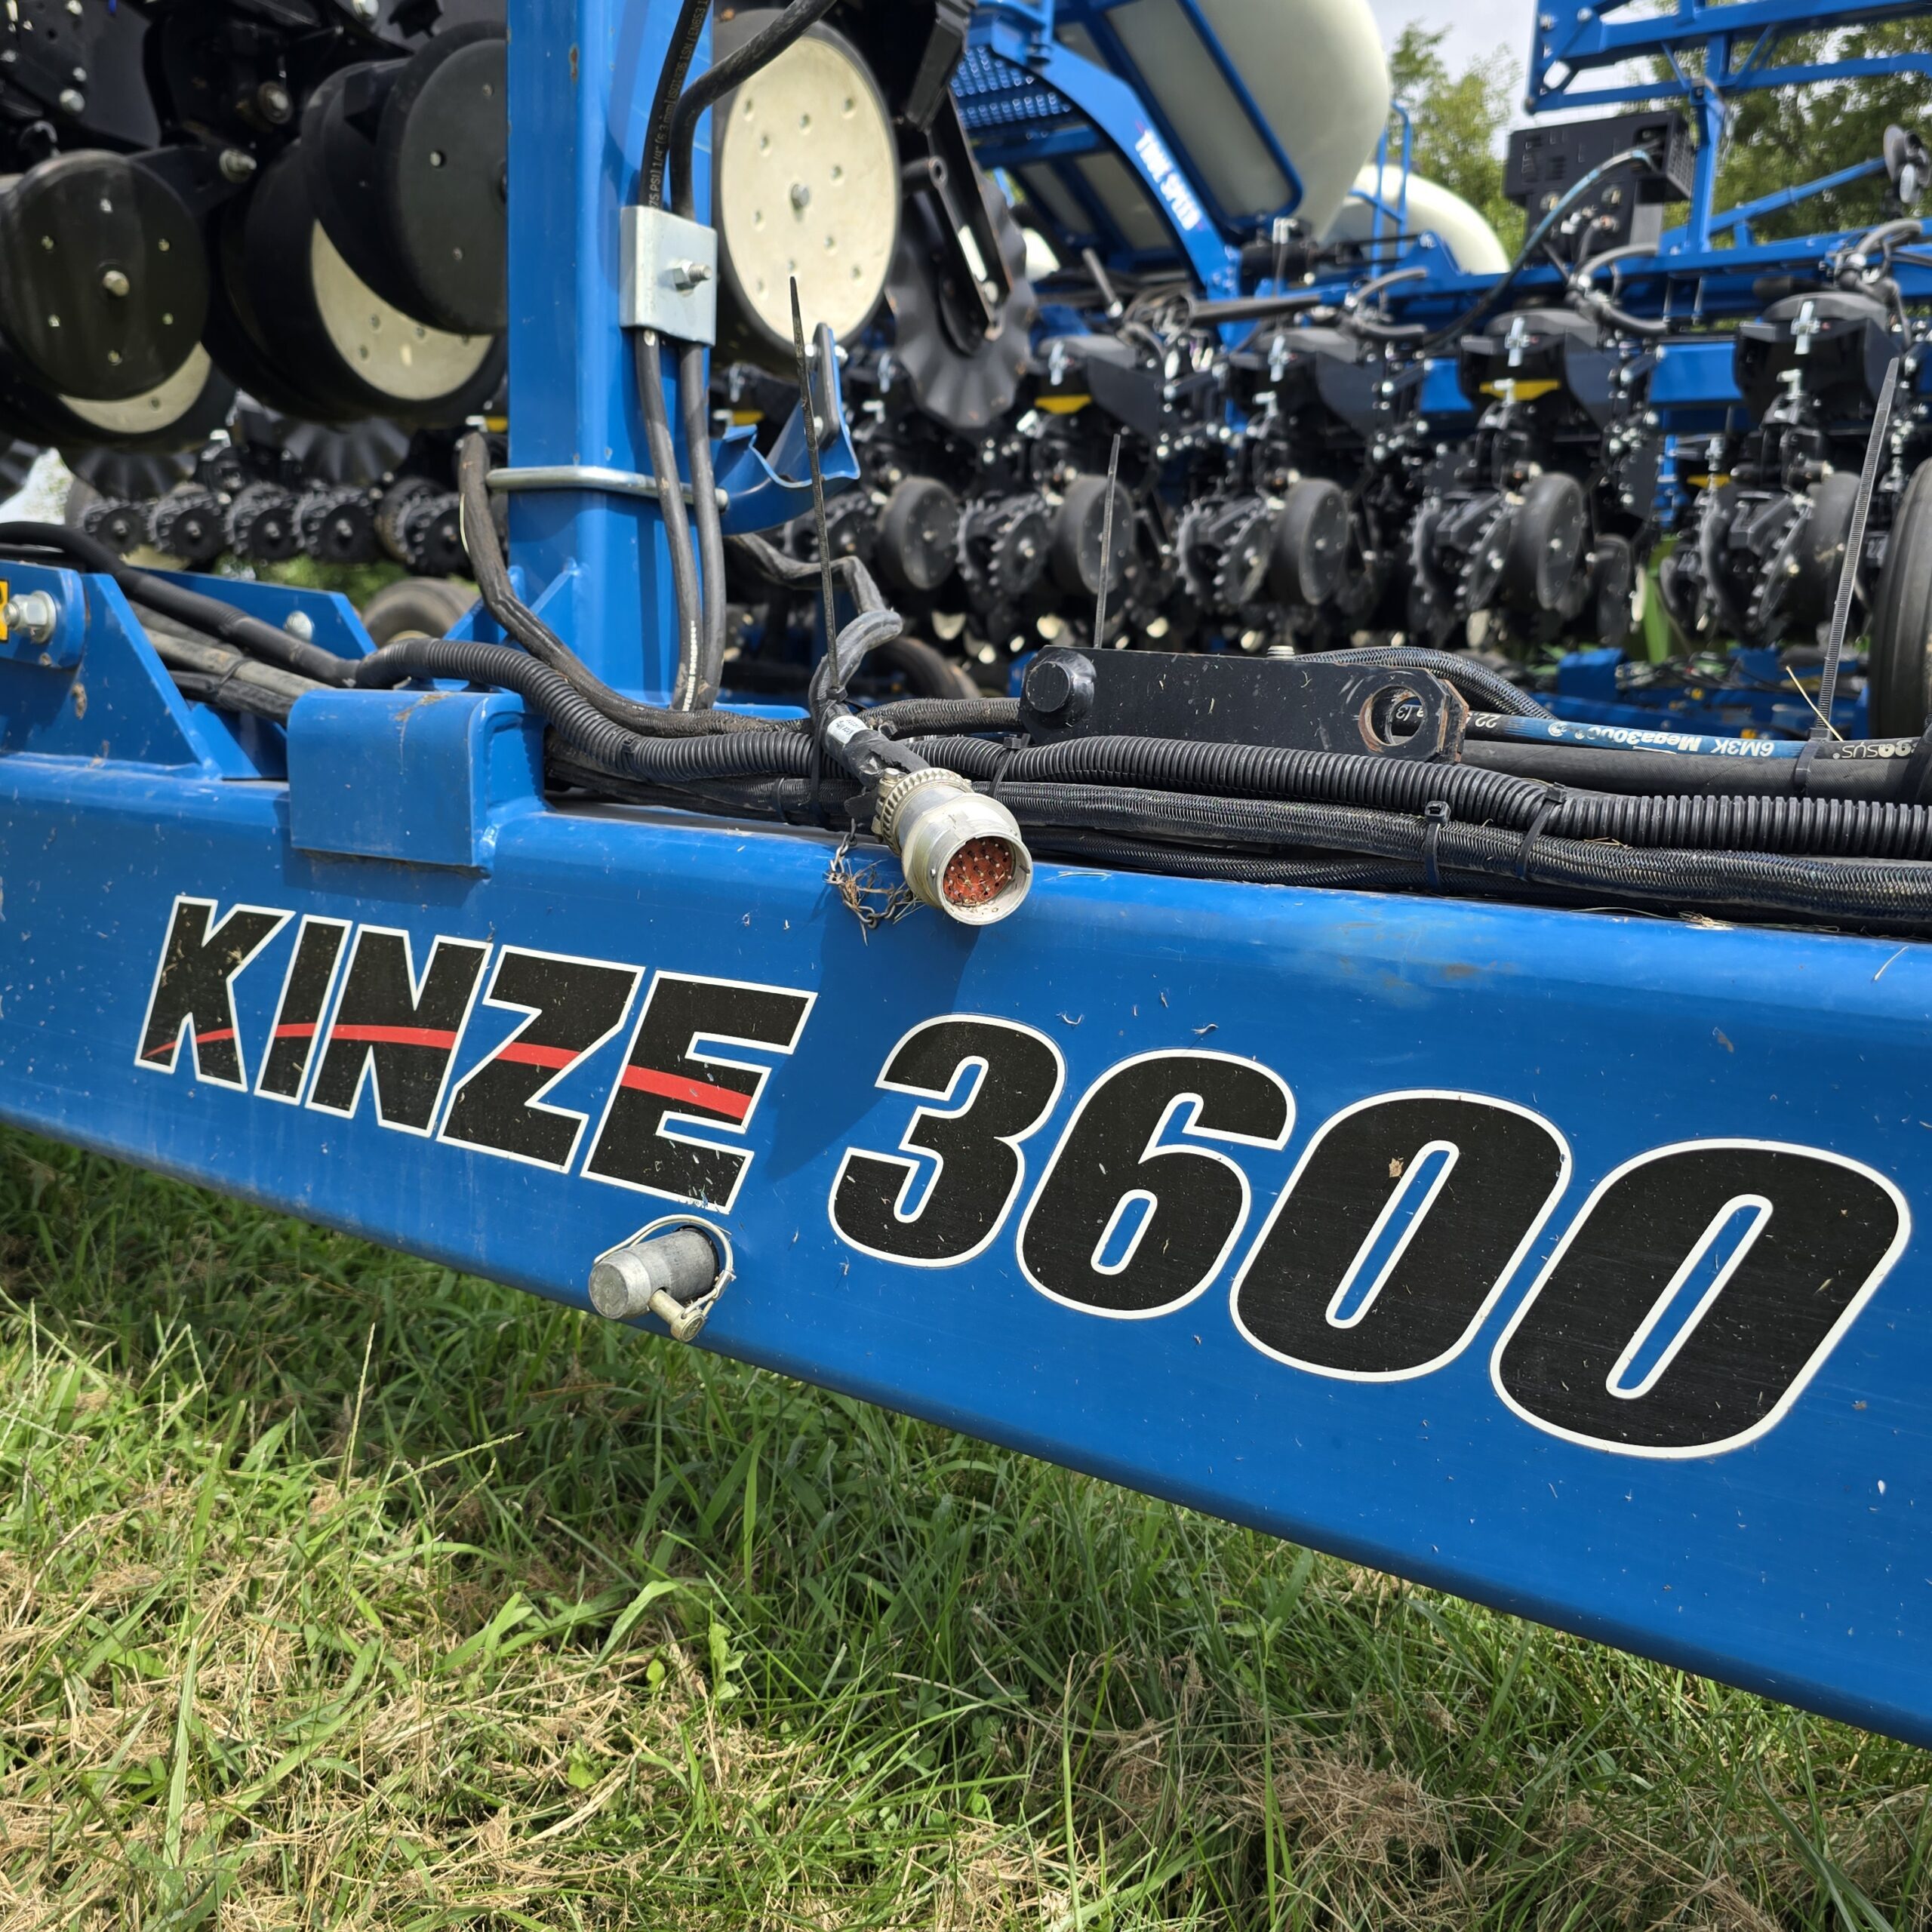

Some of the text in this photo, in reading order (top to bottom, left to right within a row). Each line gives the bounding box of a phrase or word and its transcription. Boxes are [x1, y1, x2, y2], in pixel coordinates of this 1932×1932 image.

[1710, 737, 1774, 757] 6M3K
[134, 894, 1912, 1461] KINZE 3600
